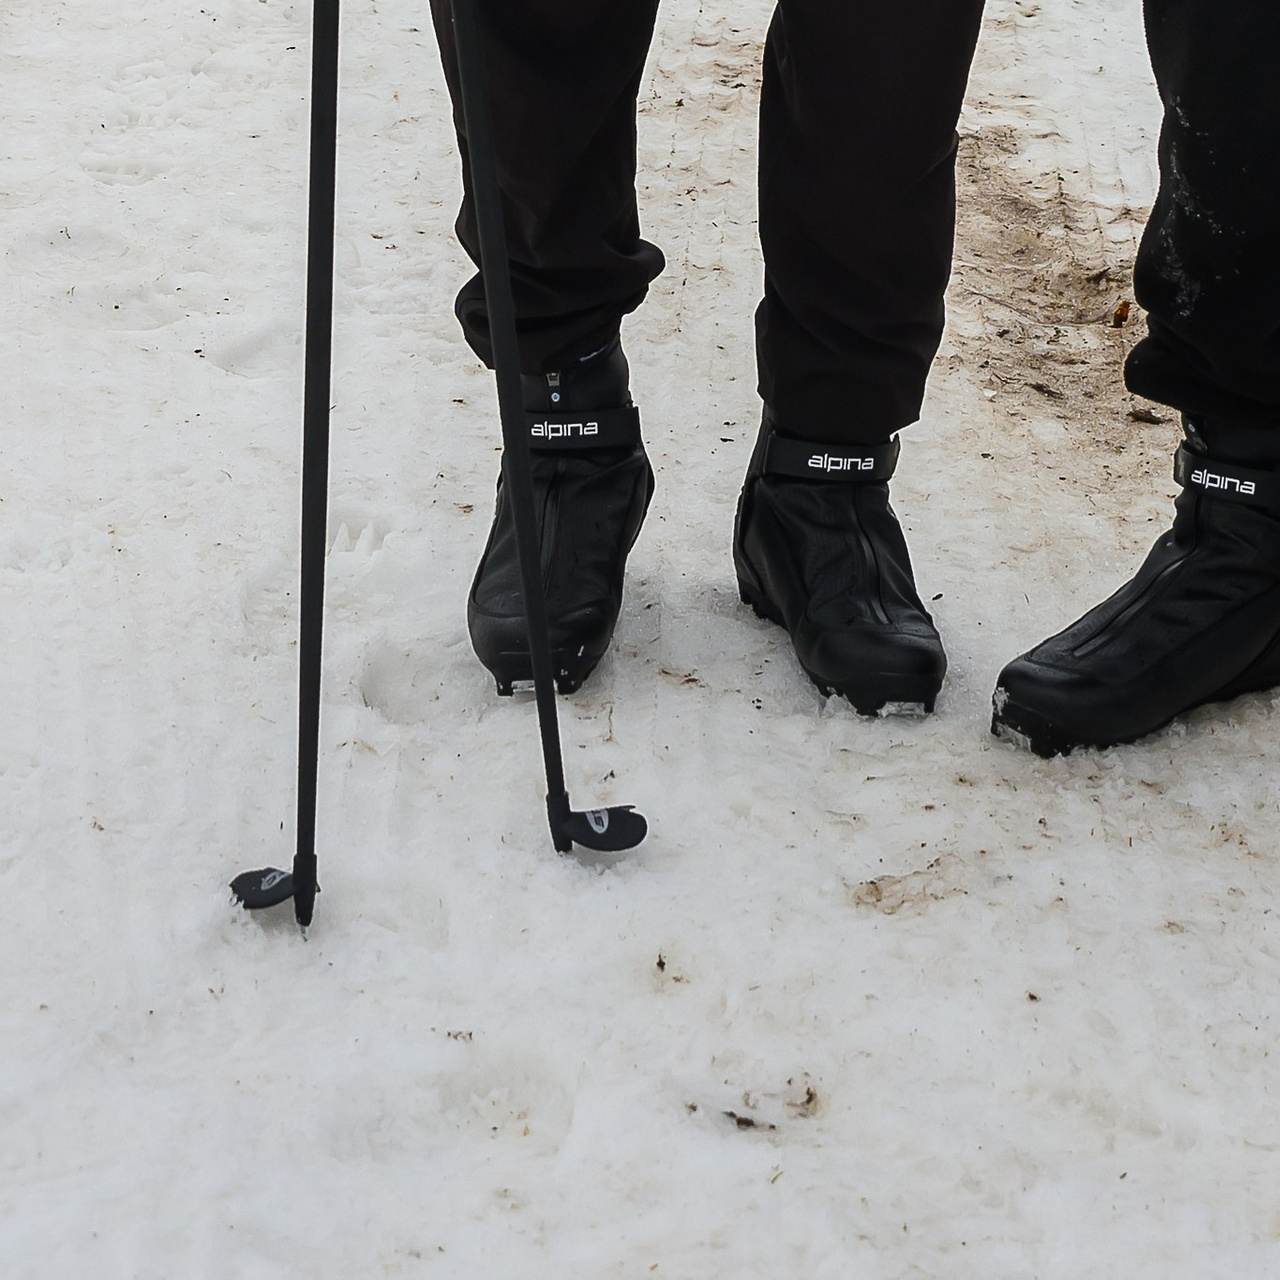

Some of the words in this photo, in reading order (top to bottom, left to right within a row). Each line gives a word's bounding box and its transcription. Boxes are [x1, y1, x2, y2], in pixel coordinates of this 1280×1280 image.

[530, 420, 599, 441] alpina
[807, 453, 875, 473] alpina
[1191, 468, 1256, 495] alpina
